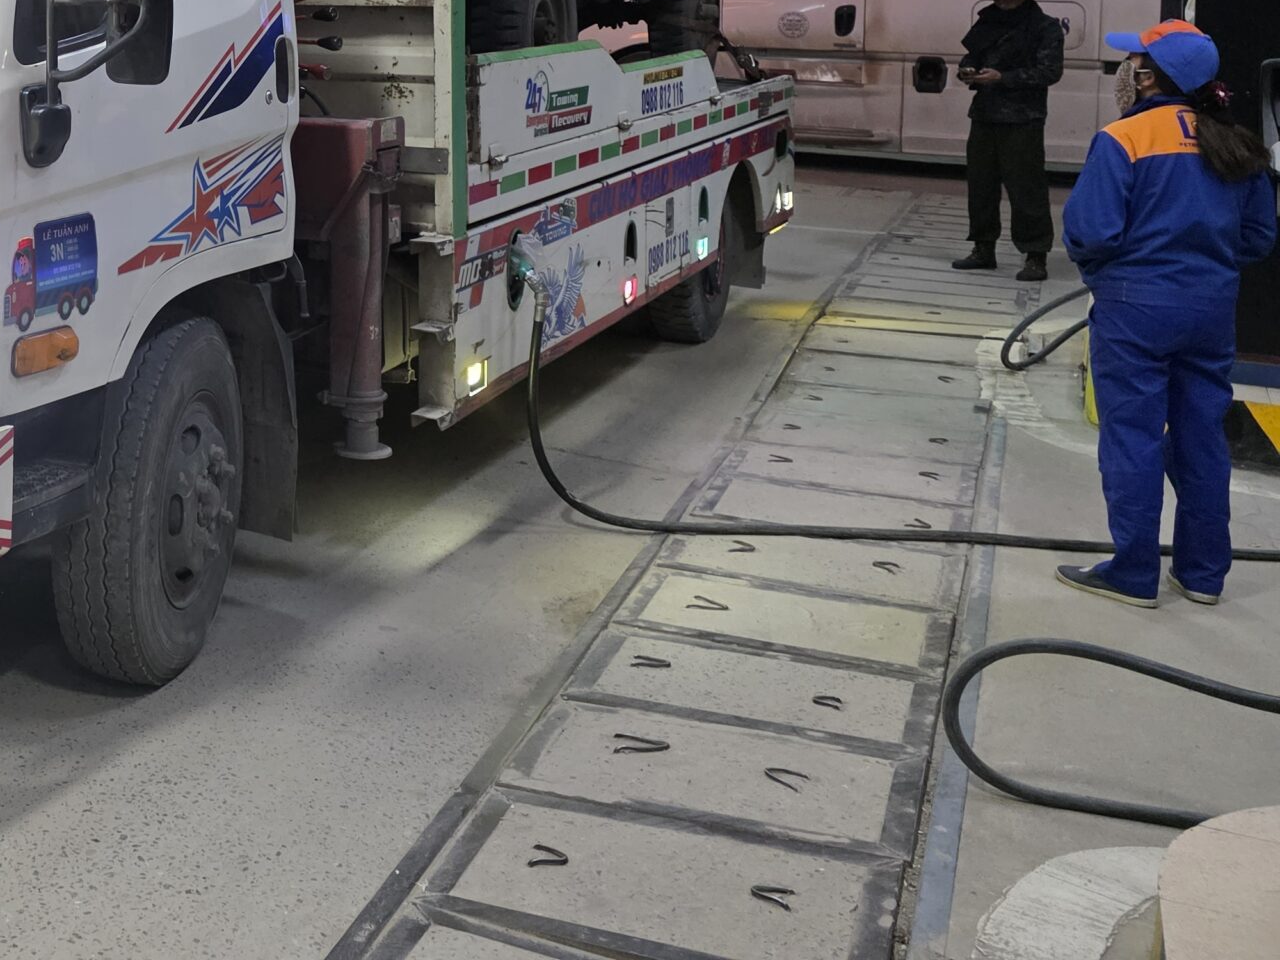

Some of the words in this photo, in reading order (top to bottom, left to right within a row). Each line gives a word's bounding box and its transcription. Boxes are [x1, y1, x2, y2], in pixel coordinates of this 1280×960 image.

[660, 83, 671, 110] 812
[673, 80, 683, 107] 116
[551, 111, 589, 128] Recovery
[666, 235, 677, 264] 812
[678, 229, 688, 256] 116
